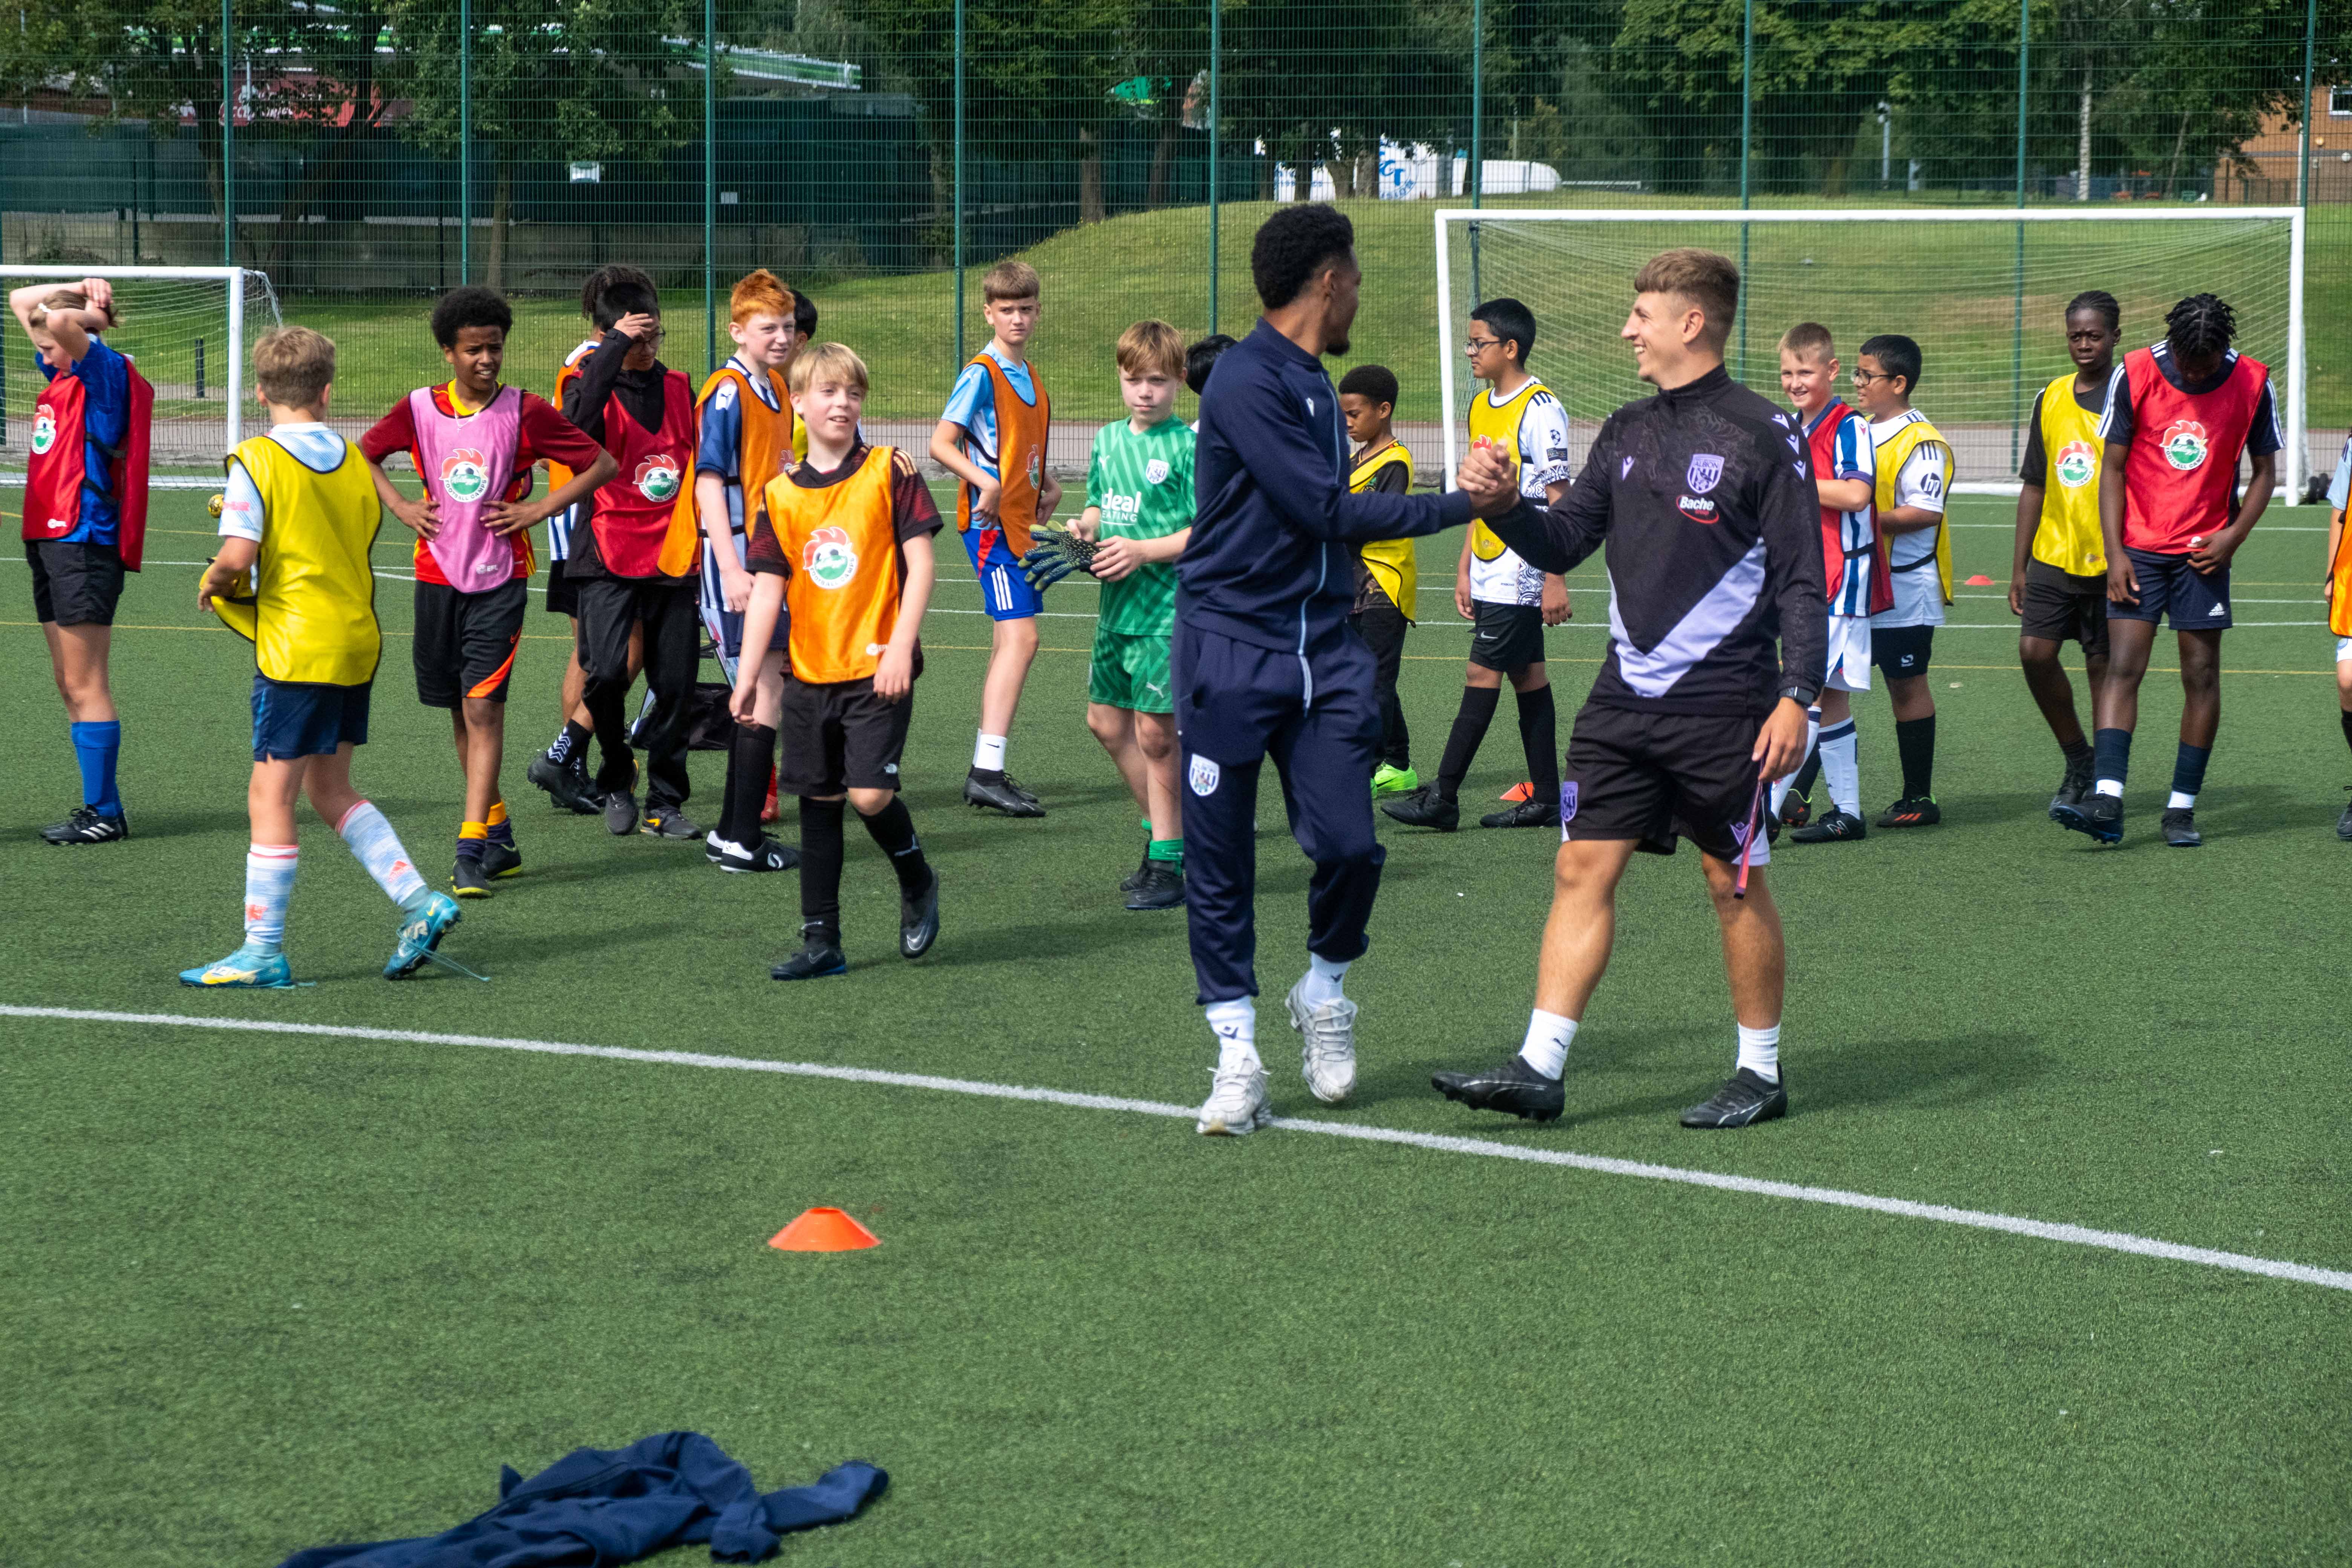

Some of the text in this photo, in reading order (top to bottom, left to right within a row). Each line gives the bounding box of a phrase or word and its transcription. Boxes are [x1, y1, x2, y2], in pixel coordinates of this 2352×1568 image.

[2166, 447, 2205, 469] FOOTBALL CAMPS
[445, 479, 487, 501] FOOTBALL CAMPS
[640, 481, 678, 501] FOOTBALL CAMPS
[1921, 472, 1941, 500] hp
[1680, 496, 1715, 511] Bache
[810, 568, 838, 586] FOOTBALL
[841, 558, 854, 582] CAMPS
